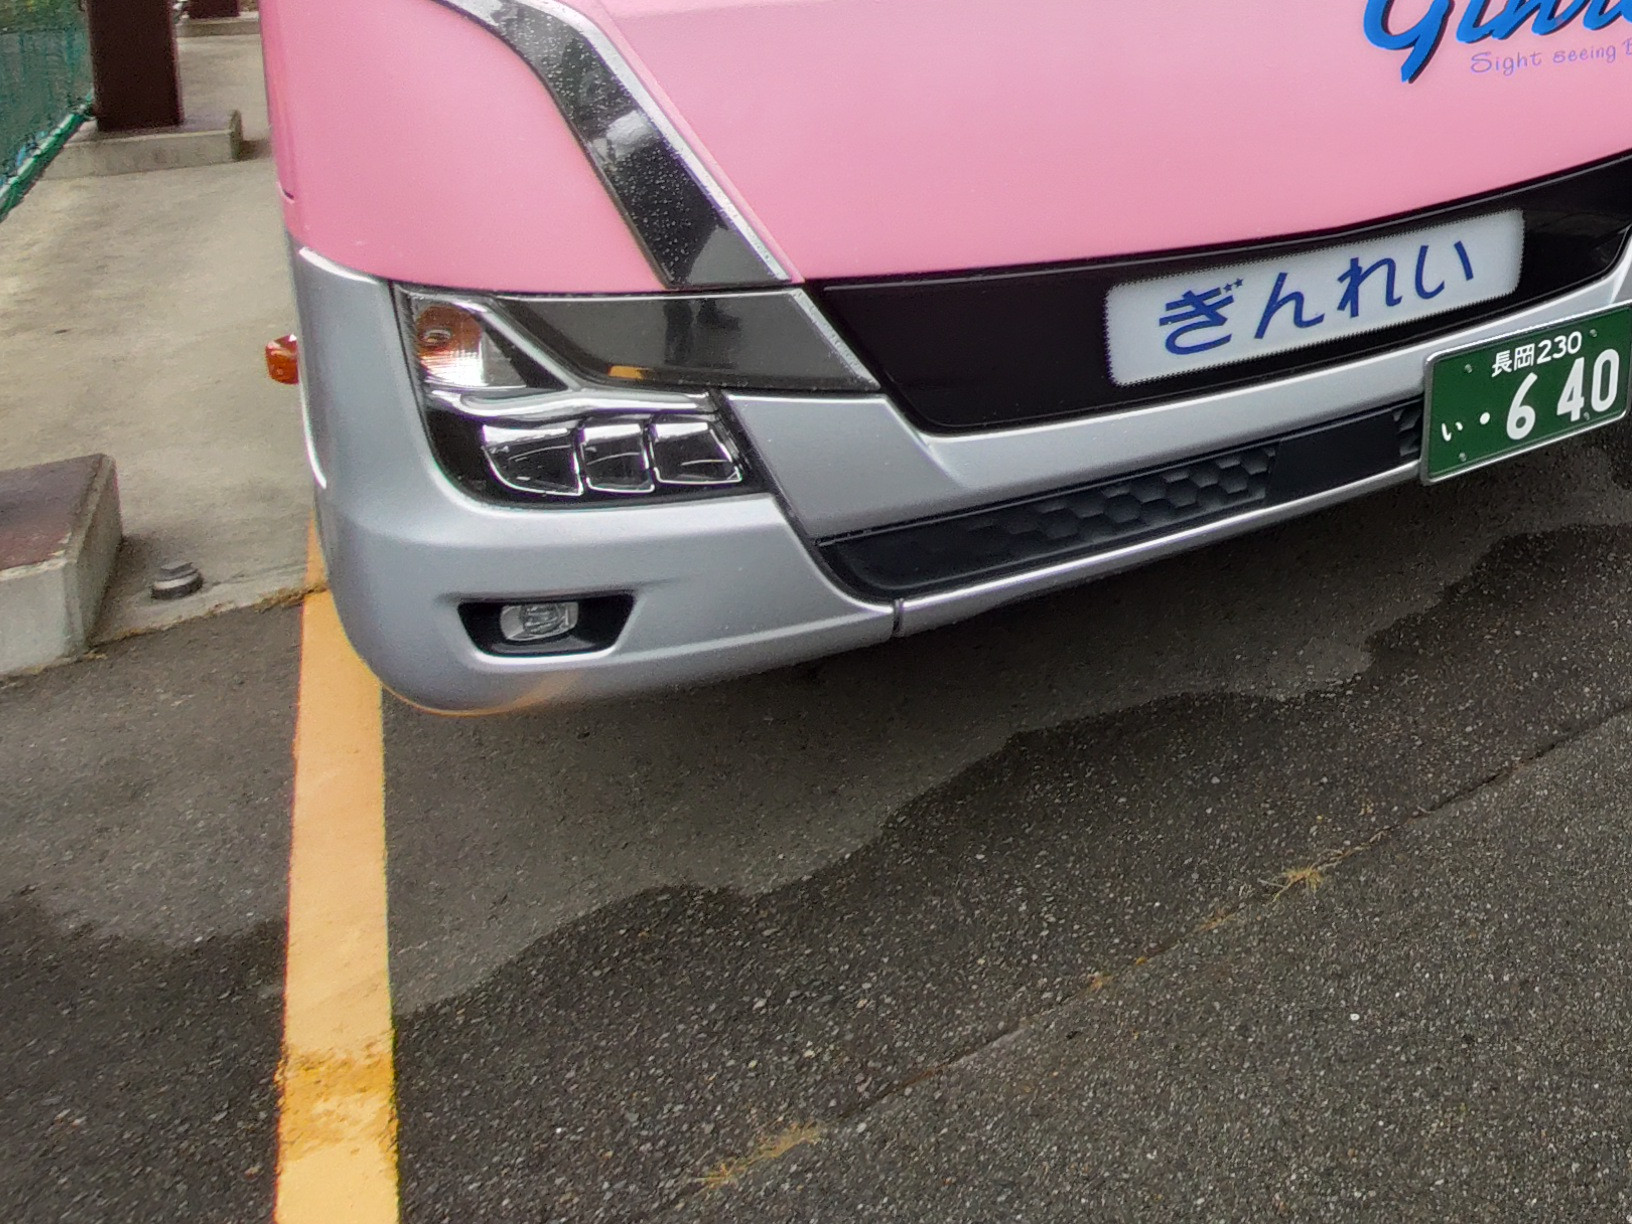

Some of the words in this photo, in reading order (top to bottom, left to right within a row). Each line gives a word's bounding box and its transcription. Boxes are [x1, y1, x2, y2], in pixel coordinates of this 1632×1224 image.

[1470, 50, 1542, 76] Sight
[1553, 42, 1617, 66] seeing
[1159, 241, 1475, 356] ぎんれい
[1491, 331, 1583, 378] 長岡230
